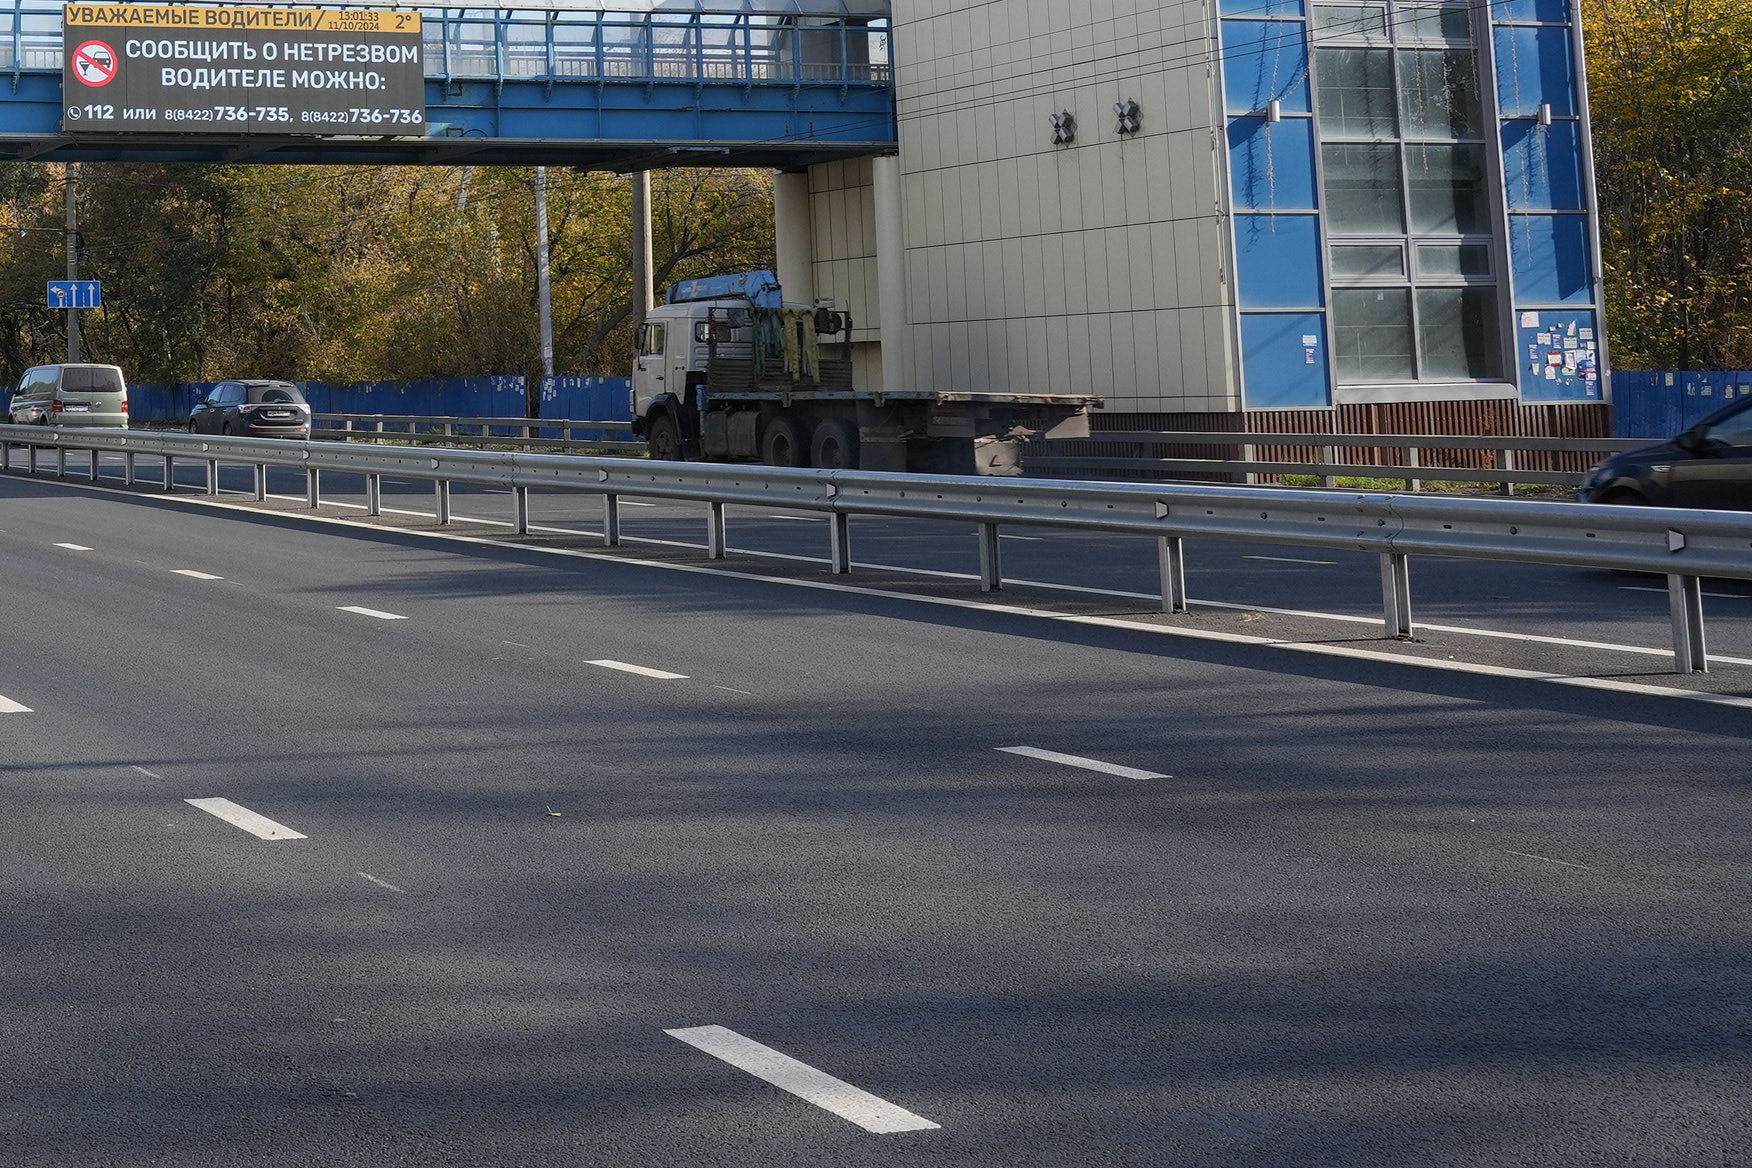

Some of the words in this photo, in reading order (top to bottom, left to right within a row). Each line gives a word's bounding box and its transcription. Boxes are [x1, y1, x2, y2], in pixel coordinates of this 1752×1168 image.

[68, 7, 200, 24] УВАЖАЕМЫЕ
[205, 9, 312, 28] ВОДИТЕЛИ
[339, 11, 379, 21] 13:01:33
[395, 15, 412, 29] 2°
[328, 21, 380, 30] 11/10/2024
[126, 39, 257, 62] СООБЩИТЬ
[262, 42, 278, 60] О
[284, 42, 418, 63] НЕТРЕЗВОМ
[161, 67, 286, 90] ВОДИТЕЛЕ
[292, 70, 386, 90] МОЖНО:
[84, 105, 114, 119] 112
